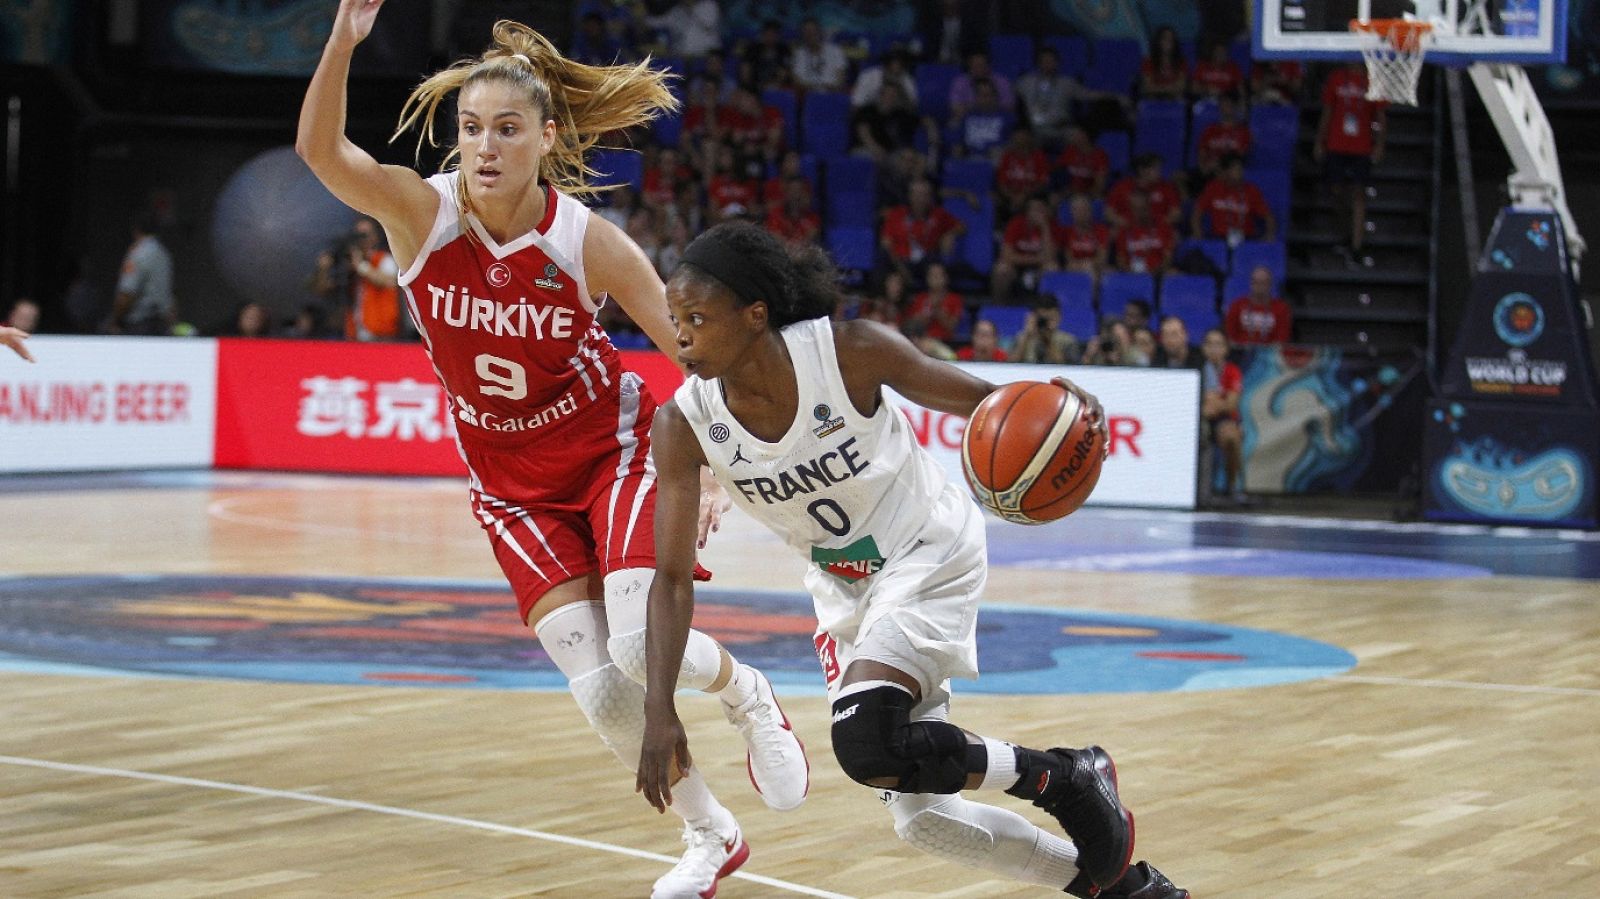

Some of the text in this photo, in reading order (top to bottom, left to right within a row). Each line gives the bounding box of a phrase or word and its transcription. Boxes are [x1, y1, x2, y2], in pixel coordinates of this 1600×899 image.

[427, 284, 575, 340] TÜRKİYE
[475, 353, 528, 400] 9
[115, 383, 191, 422] BEER
[297, 376, 456, 441] 燕京
[480, 393, 578, 431] Garanti
[733, 436, 871, 504] FRANCE
[1051, 428, 1097, 490] molte
[807, 498, 850, 537] 0
